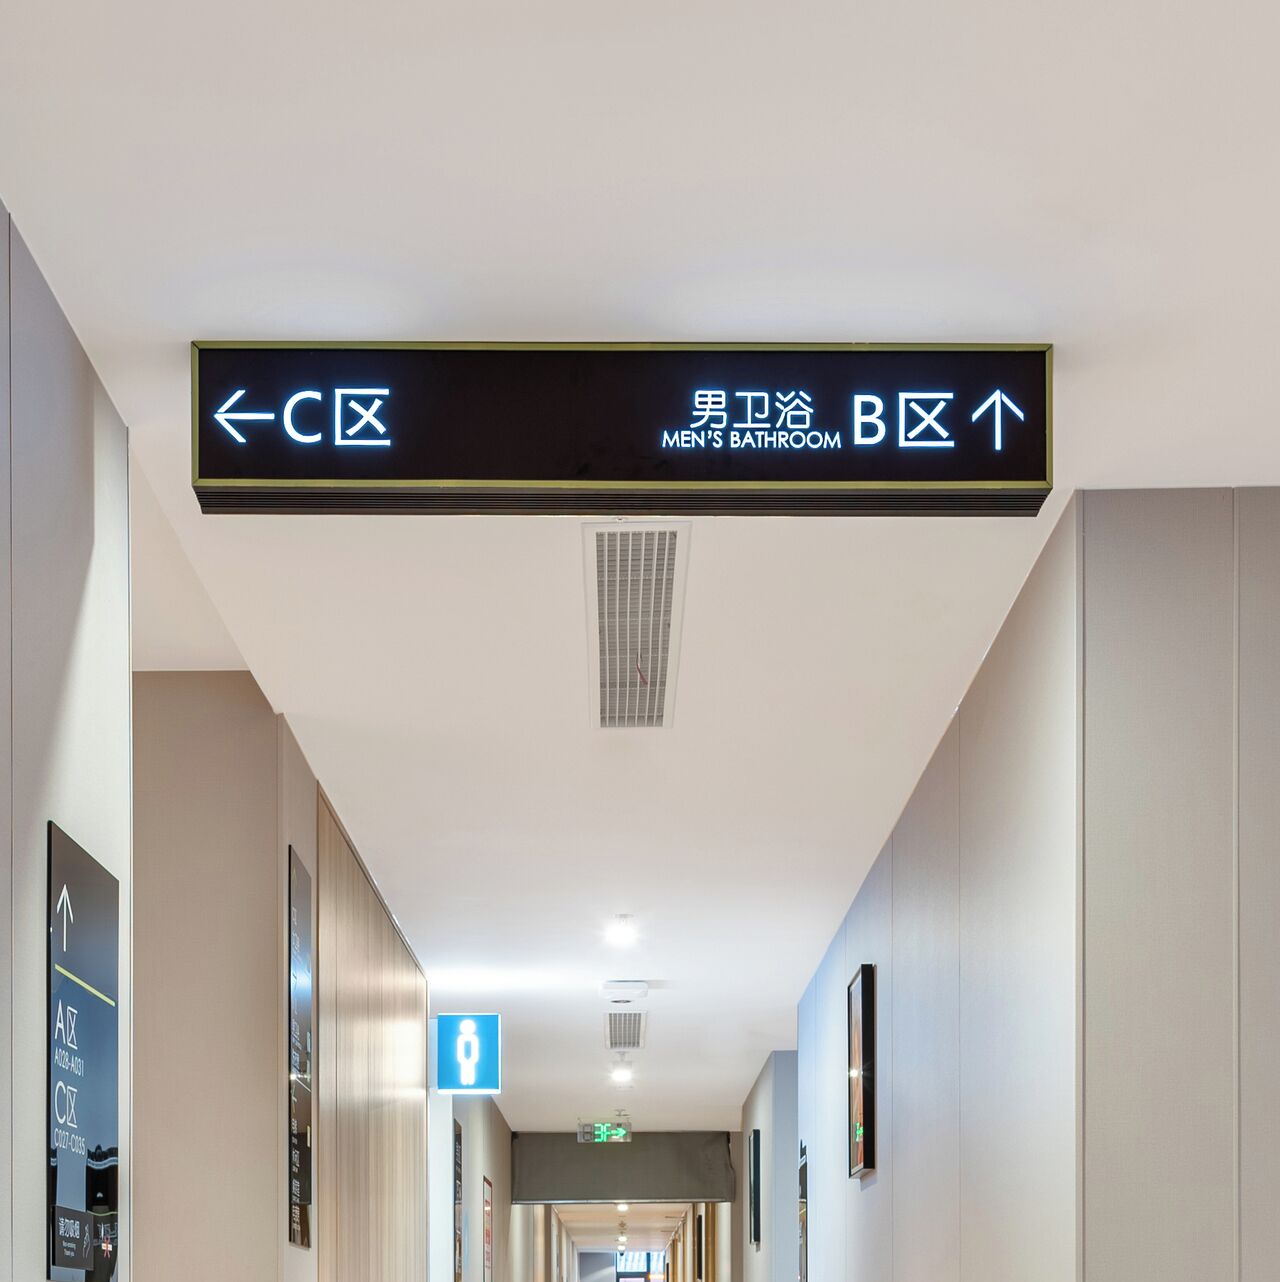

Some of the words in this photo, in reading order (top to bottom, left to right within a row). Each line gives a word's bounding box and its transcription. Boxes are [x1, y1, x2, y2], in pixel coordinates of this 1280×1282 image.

[283, 388, 391, 446] C区
[689, 389, 814, 429] 男卫浴
[854, 392, 955, 447] B区
[730, 430, 842, 449] BATHROOM
[54, 999, 78, 1050] A区
[54, 1080, 78, 1128] C区
[594, 1122, 612, 1143] 3F
